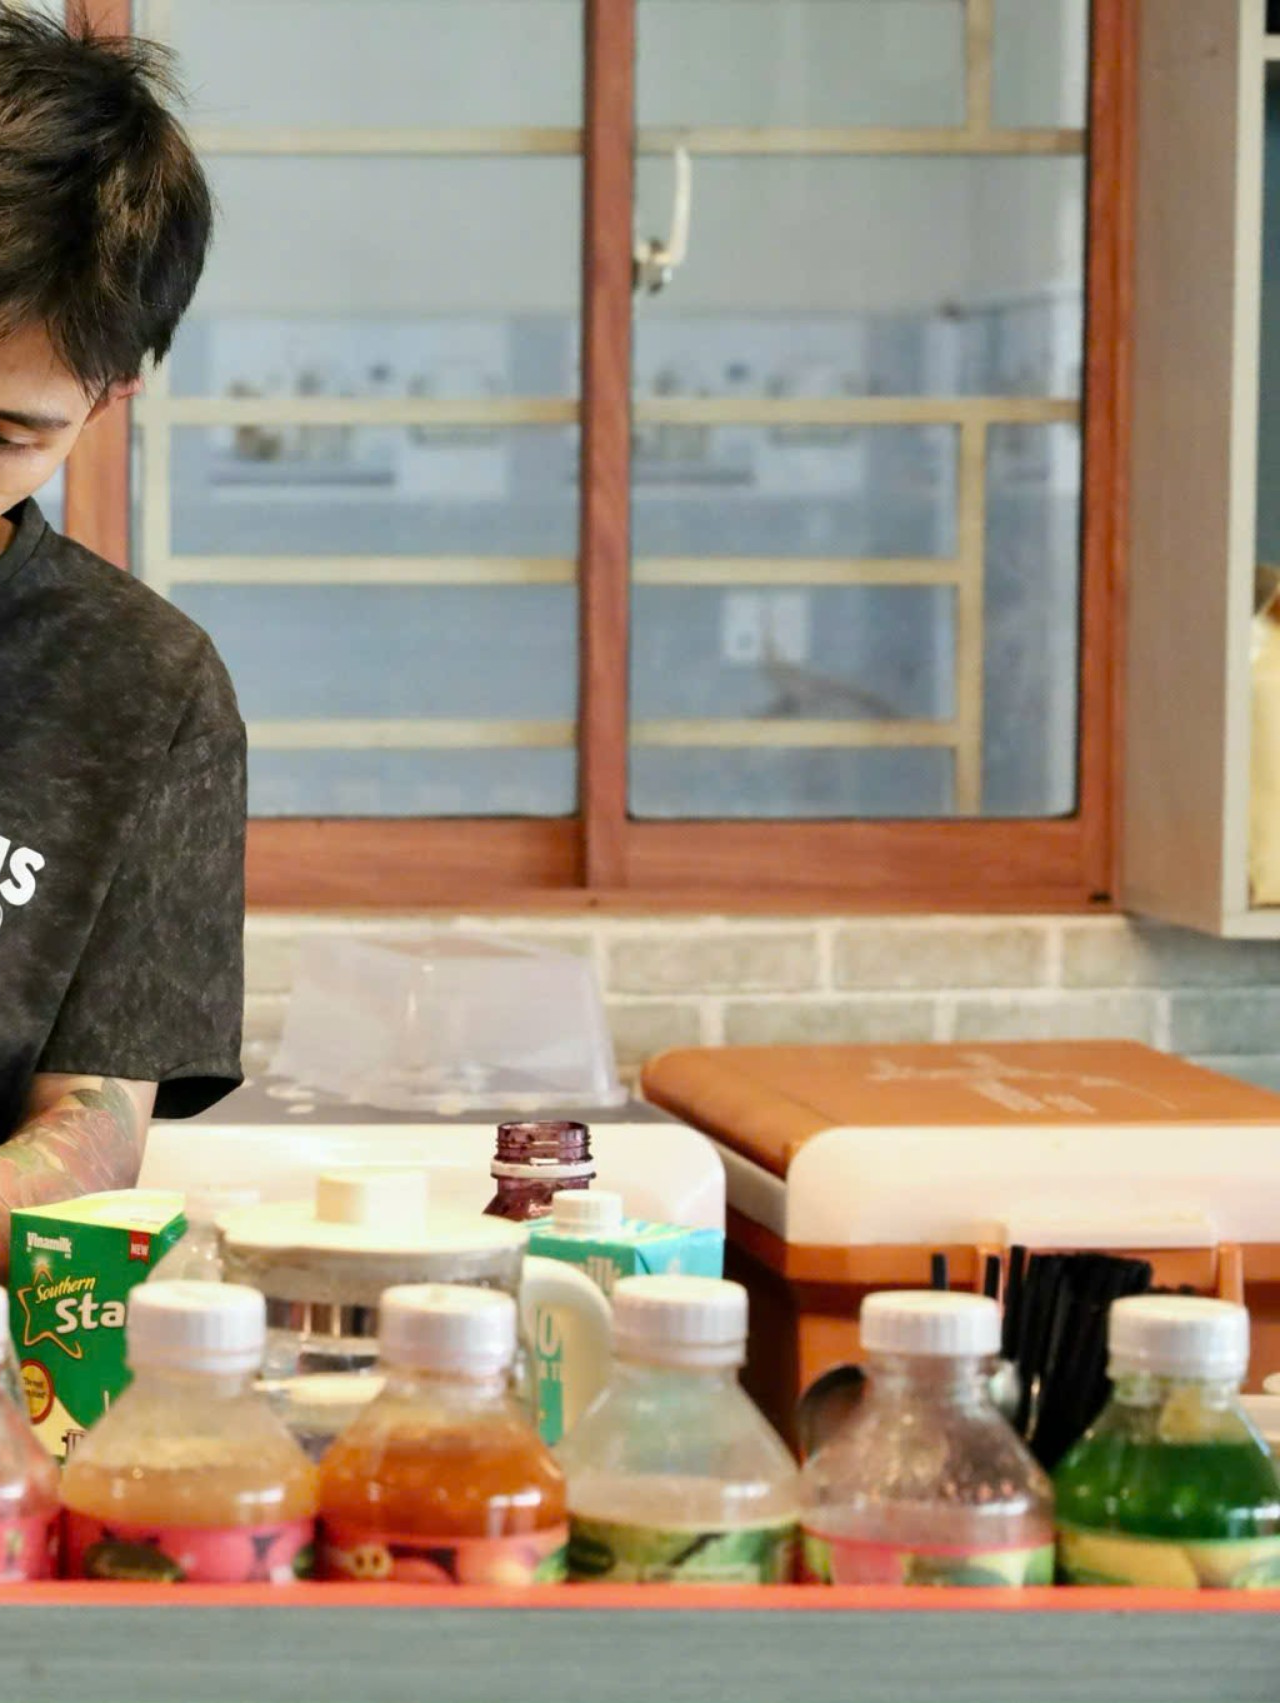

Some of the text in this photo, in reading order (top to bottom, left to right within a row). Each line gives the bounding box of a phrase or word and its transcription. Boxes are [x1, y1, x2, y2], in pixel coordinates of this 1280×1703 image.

[130, 1242, 150, 1256] NEW
[35, 1275, 96, 1305] Southern
[55, 1292, 127, 1335] Sta
